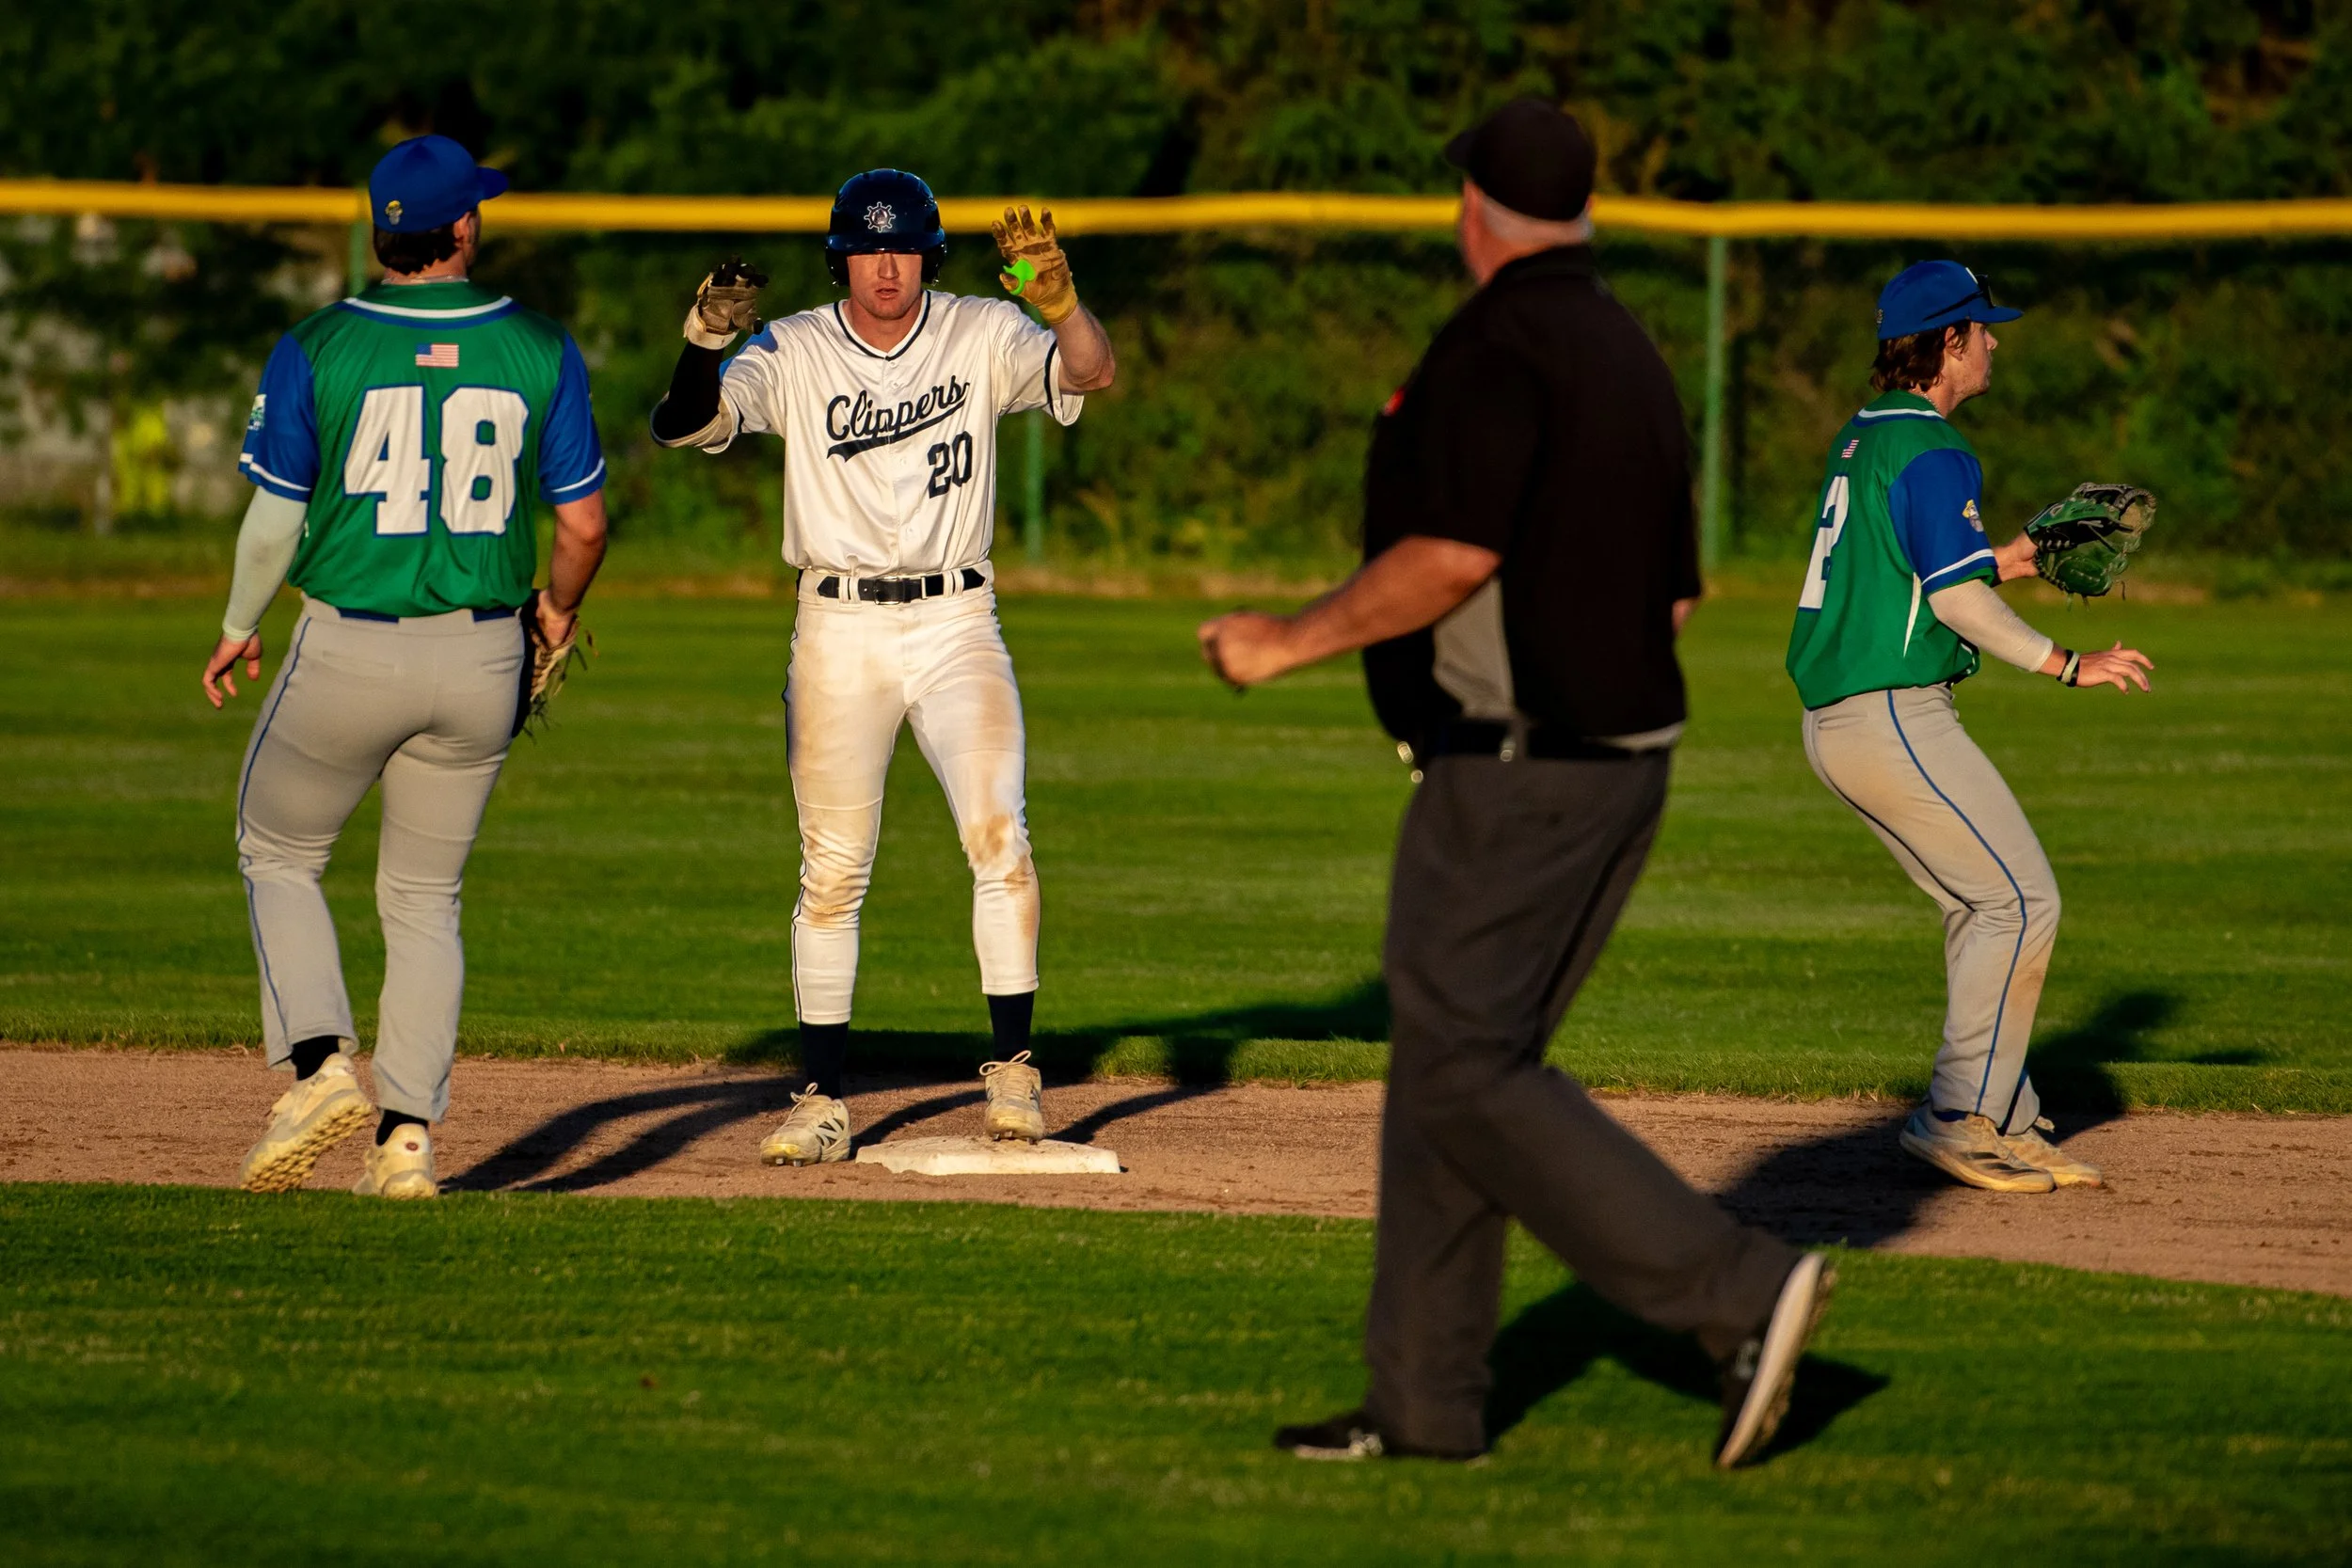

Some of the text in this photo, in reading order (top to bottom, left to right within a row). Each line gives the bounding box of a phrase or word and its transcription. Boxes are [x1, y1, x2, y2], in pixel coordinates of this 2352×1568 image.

[826, 374, 971, 442] Clippers
[342, 384, 530, 537] 48
[927, 431, 973, 499] 20
[1798, 474, 1851, 610] 2
